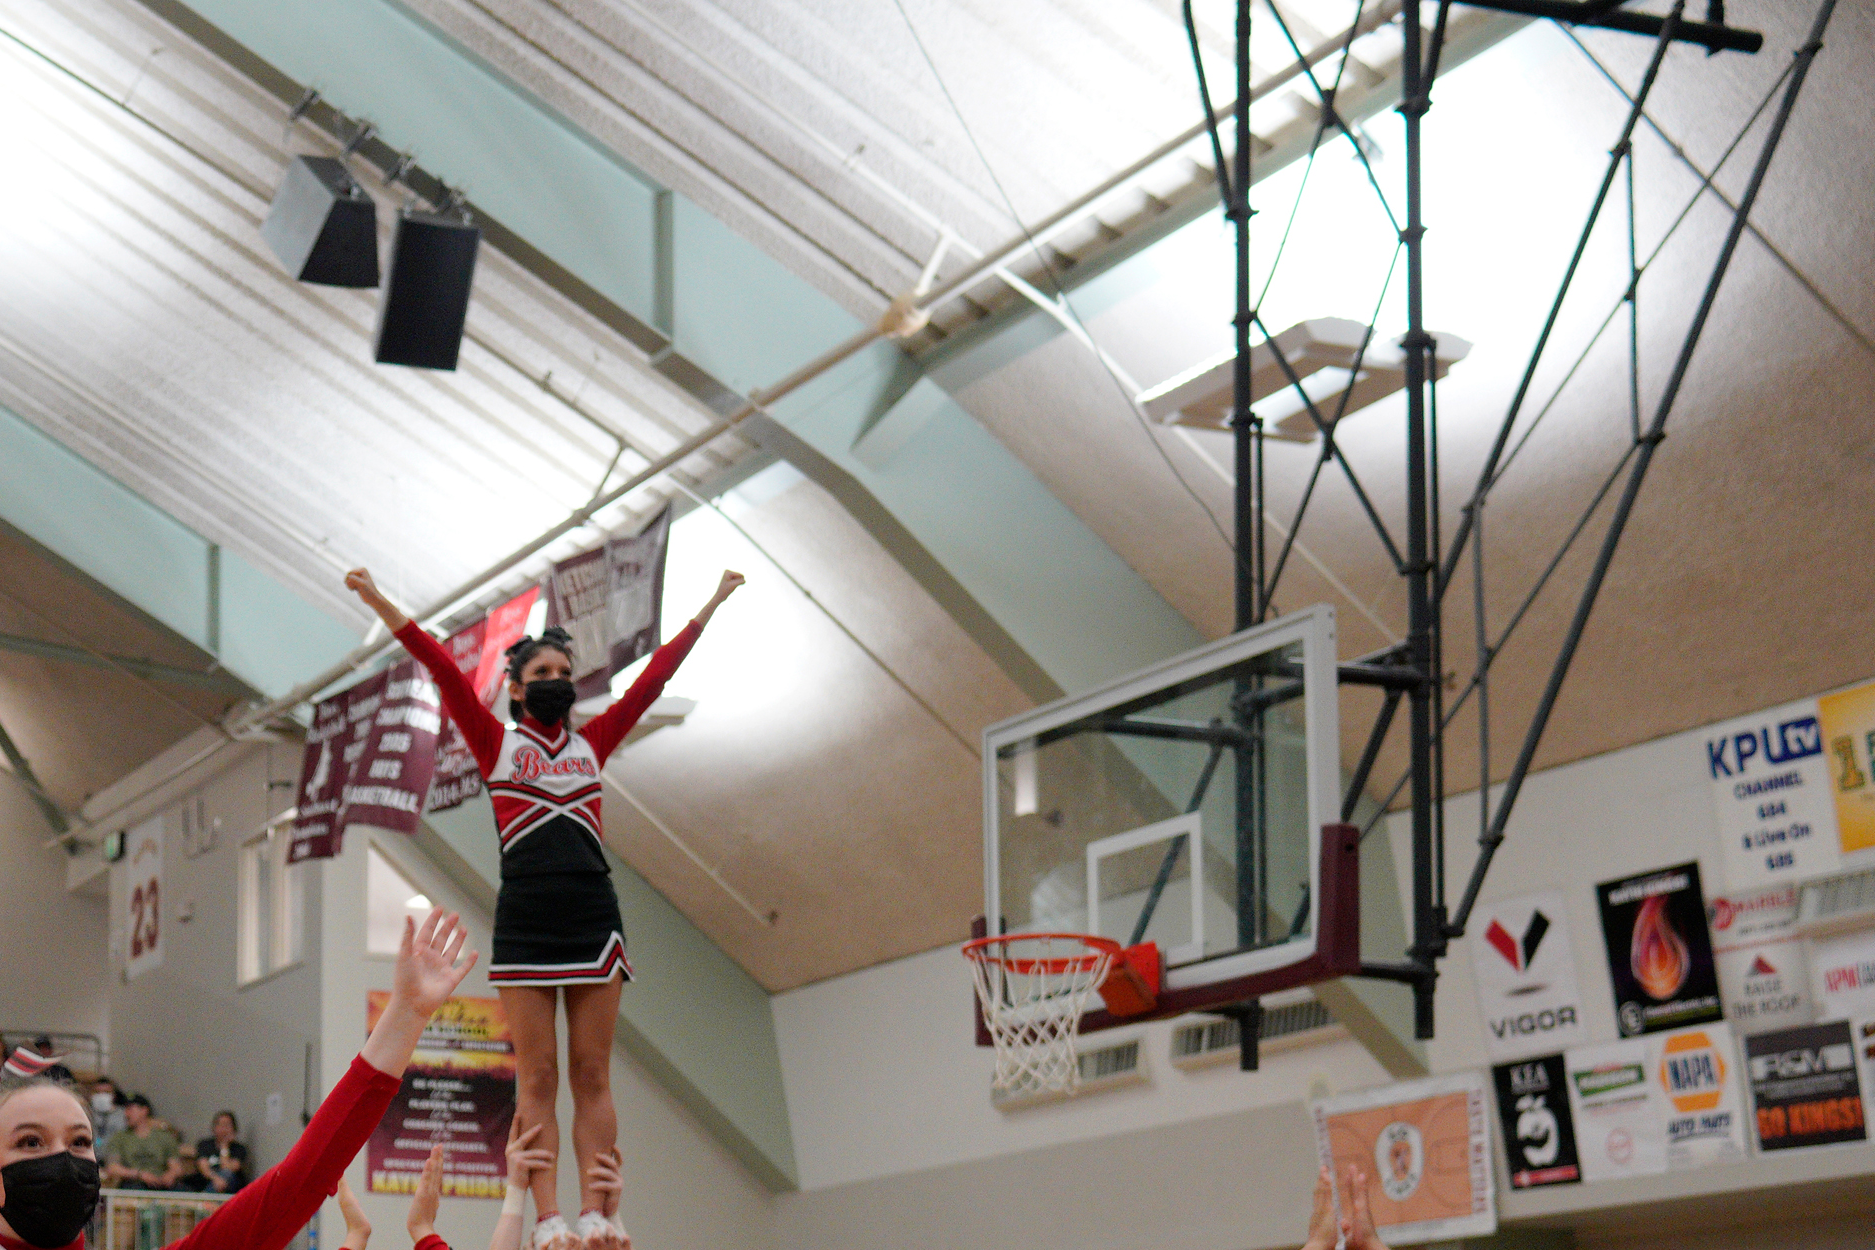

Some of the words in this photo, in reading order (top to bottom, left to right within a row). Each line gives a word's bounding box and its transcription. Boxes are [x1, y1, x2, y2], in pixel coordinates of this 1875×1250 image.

[509, 745, 597, 785] Bears
[130, 877, 160, 959] 23
[1489, 1005, 1579, 1040] VIGOR
[1667, 1053, 1717, 1092] NAPA
